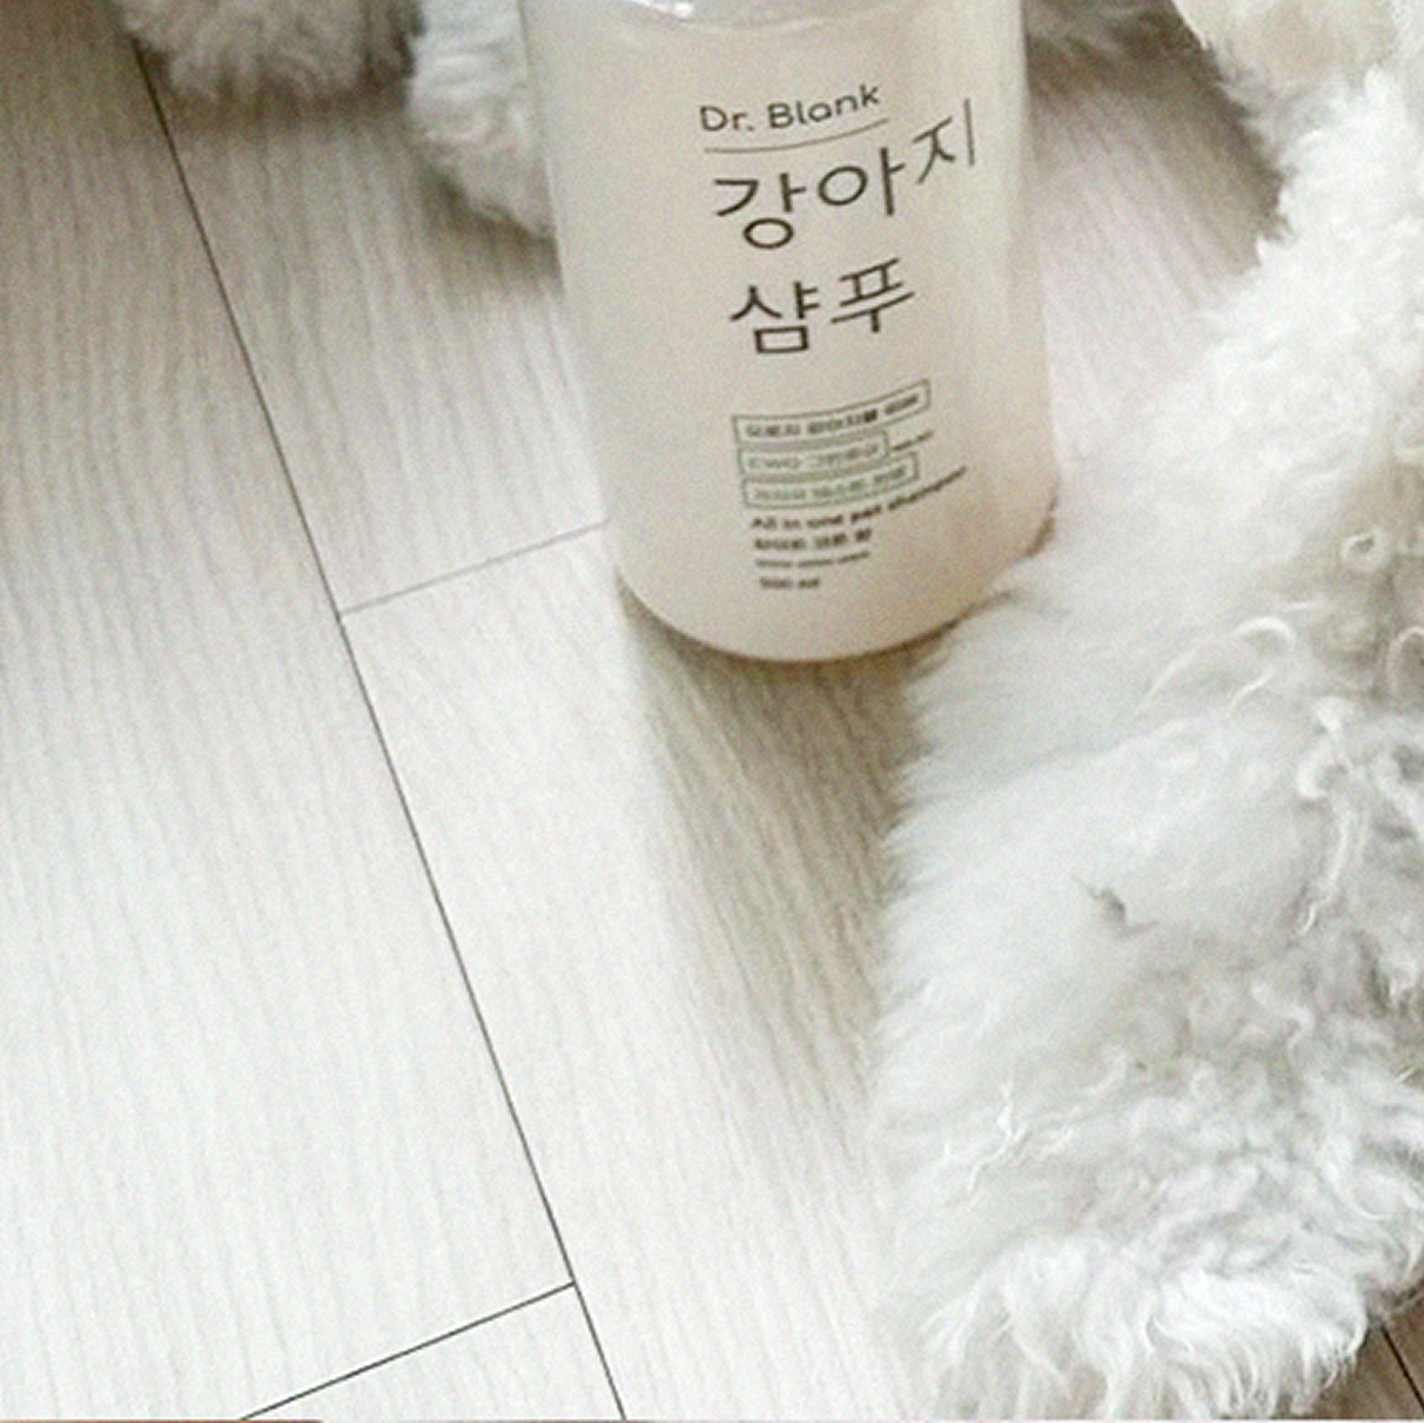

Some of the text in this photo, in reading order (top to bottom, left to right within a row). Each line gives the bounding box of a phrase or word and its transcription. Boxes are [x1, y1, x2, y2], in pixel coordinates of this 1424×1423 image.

[699, 83, 881, 132] Dr. Blank
[712, 97, 976, 250] 강아지
[729, 257, 916, 355] 샴푸
